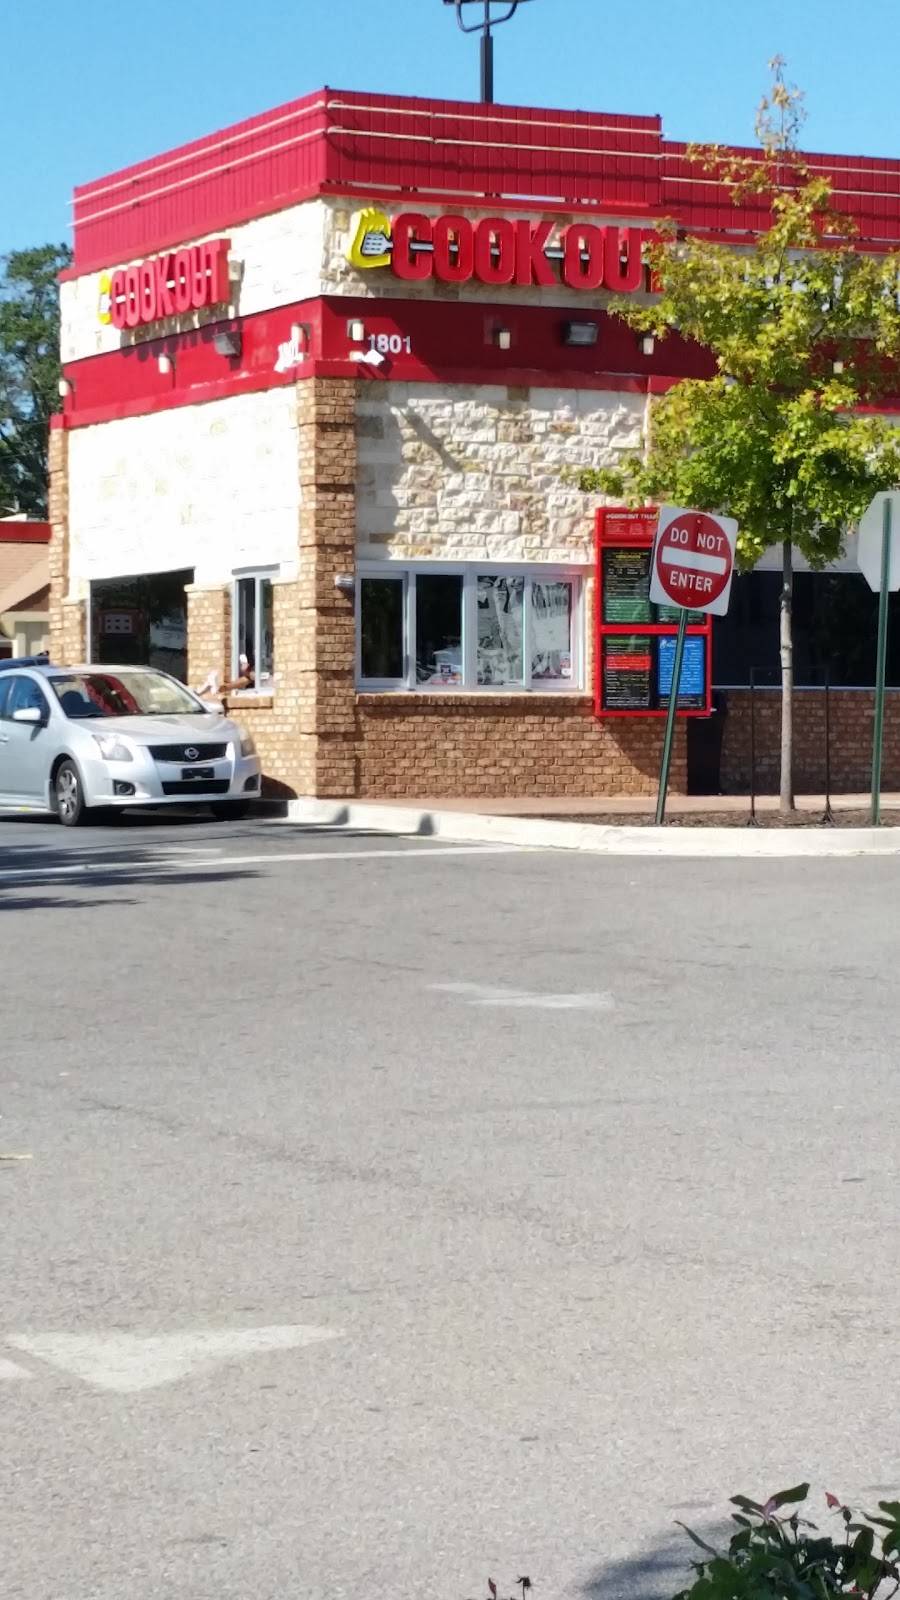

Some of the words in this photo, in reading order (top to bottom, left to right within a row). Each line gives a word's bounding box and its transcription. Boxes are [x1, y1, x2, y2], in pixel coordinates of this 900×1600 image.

[392, 212, 557, 286] COOK
[110, 252, 177, 330] COOK
[174, 238, 231, 313] OUT
[368, 333, 412, 354] 1801
[670, 527, 689, 544] DO
[696, 533, 724, 552] NOT
[669, 570, 713, 593] ENTER
